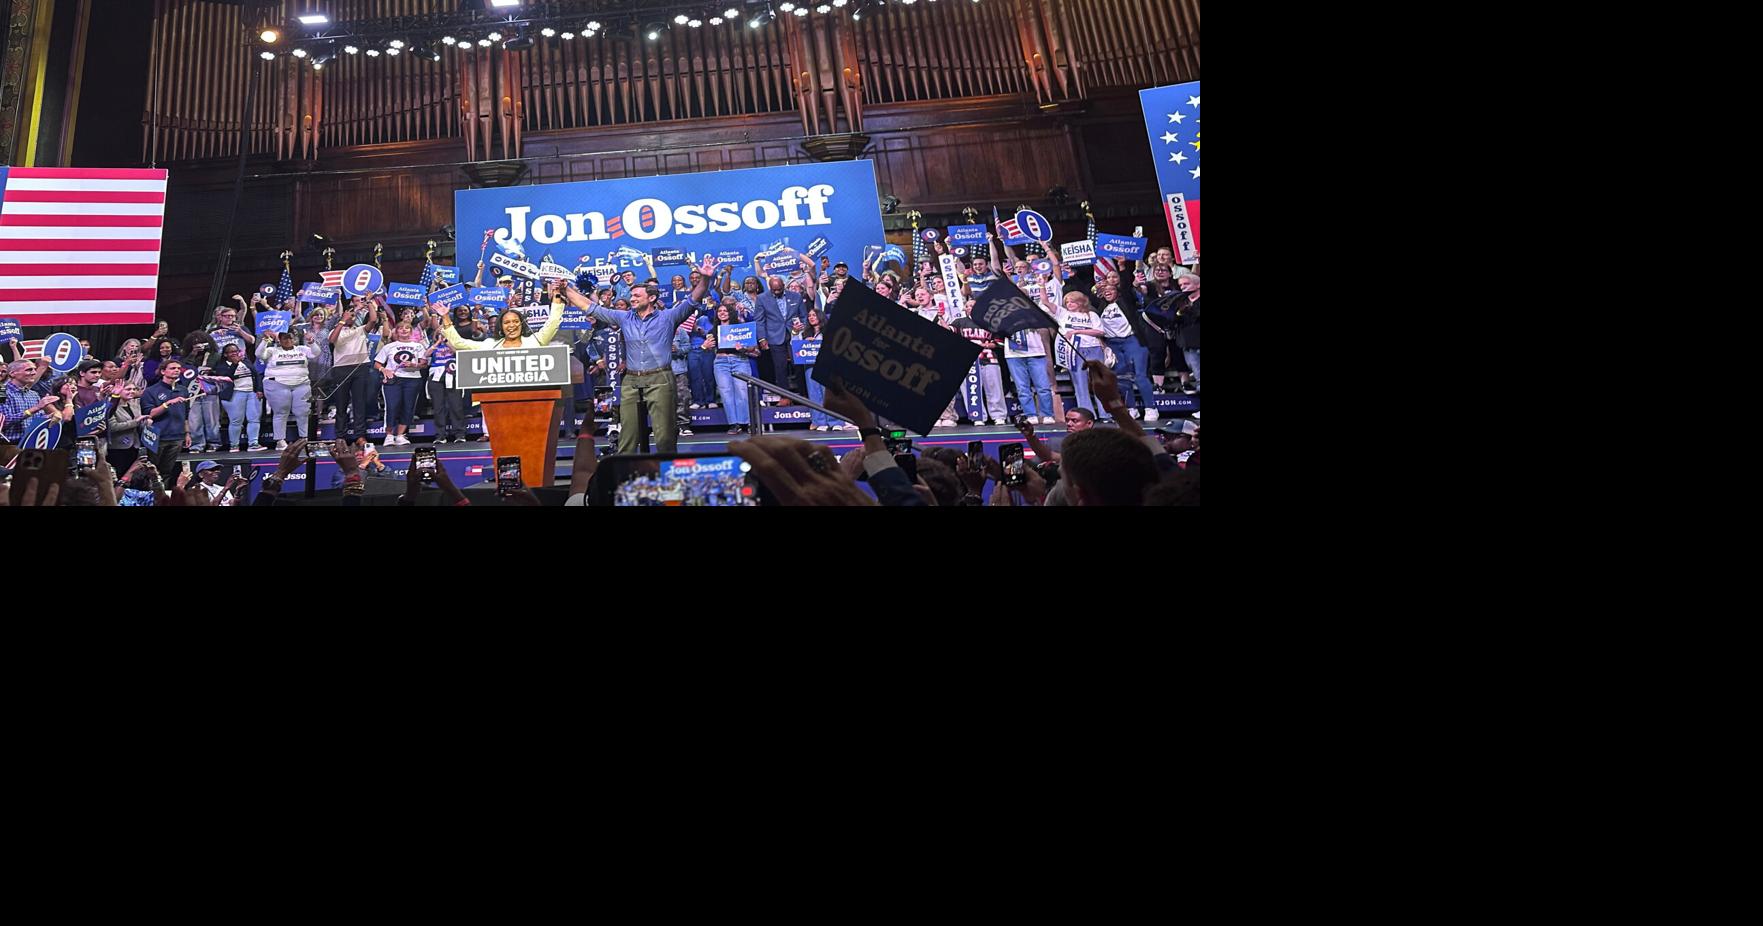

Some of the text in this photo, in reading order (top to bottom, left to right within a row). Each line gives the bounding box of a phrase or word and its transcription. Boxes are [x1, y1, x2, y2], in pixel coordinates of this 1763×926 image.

[493, 184, 835, 246] Jon Ossoff
[853, 308, 936, 359] Atlanta
[799, 349, 819, 357] Oss
[831, 326, 942, 396] Ossoff
[471, 354, 555, 375] UNITED
[487, 371, 549, 384] GEORGIA
[774, 411, 811, 419] Jon Oss
[692, 460, 734, 473] Ossoff
